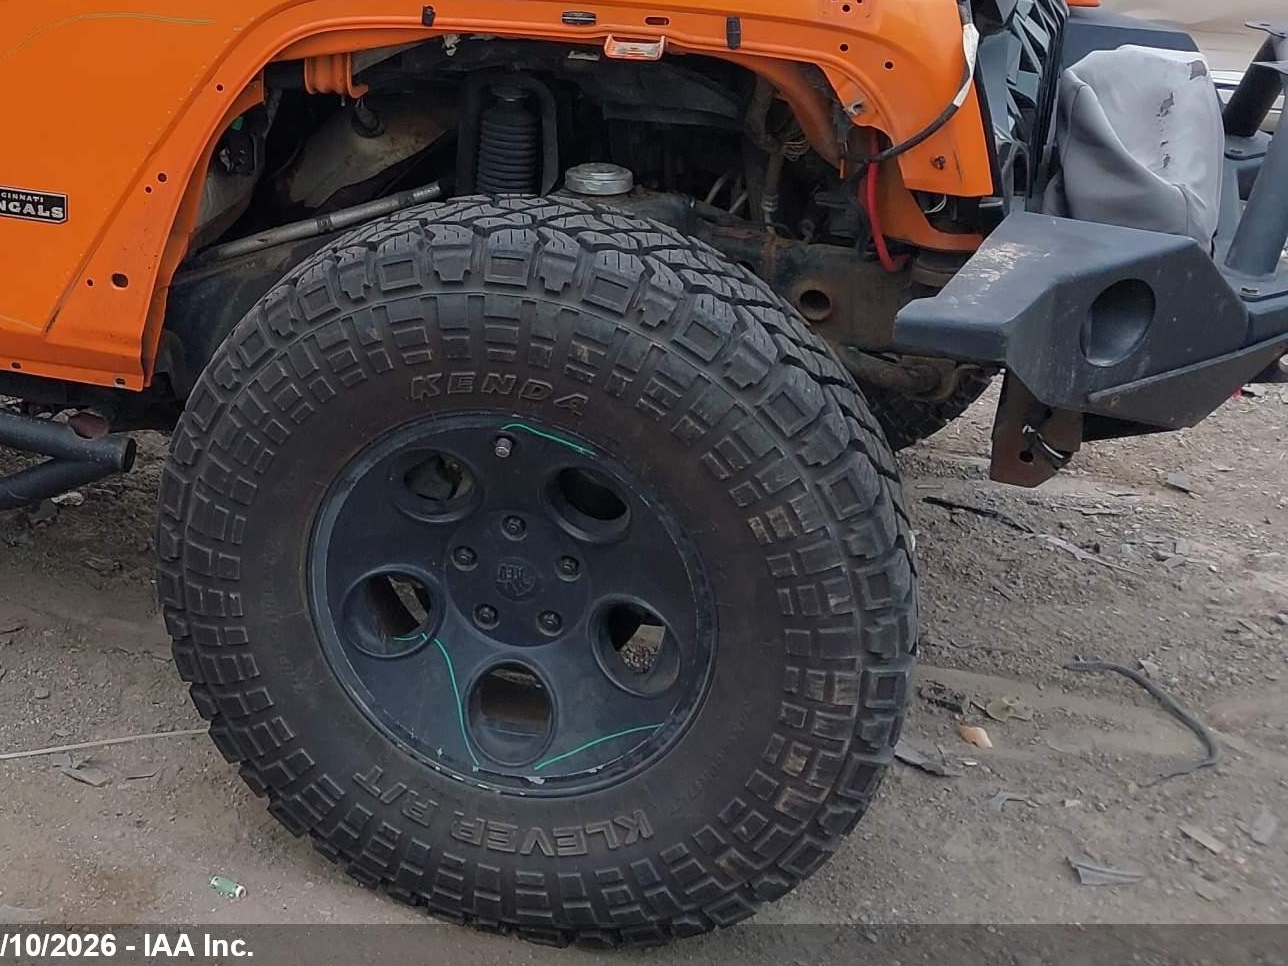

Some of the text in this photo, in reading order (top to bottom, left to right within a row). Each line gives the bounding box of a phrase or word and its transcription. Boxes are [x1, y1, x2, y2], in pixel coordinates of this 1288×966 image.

[409, 372, 589, 416] KENDA
[353, 763, 654, 858] KLEVER R/T
